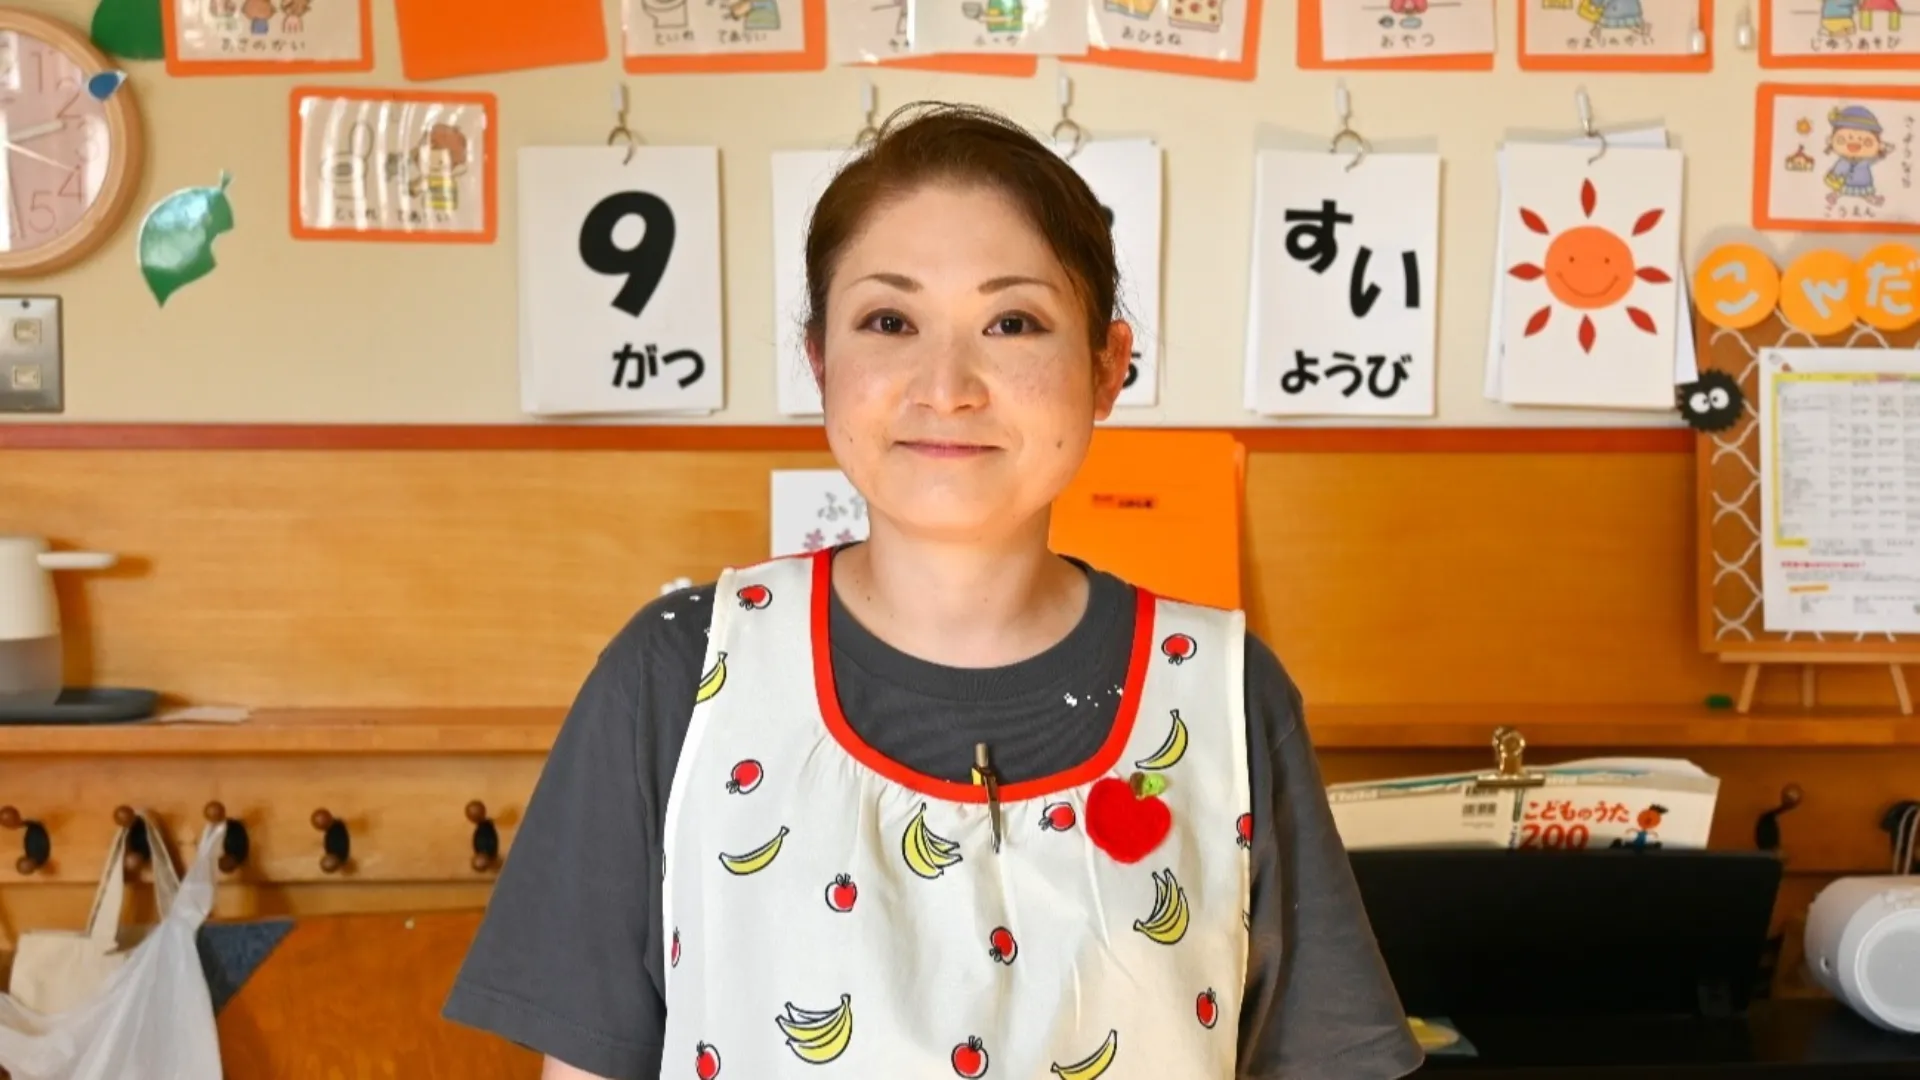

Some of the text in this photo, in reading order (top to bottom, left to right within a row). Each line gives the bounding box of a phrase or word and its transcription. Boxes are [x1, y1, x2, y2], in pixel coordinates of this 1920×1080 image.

[1121, 25, 1182, 46] おひるね
[1380, 32, 1436, 49] おやつ
[57, 162, 86, 204] 4
[29, 190, 57, 234] 5
[578, 190, 676, 319] 9
[1283, 199, 1422, 319] すい
[611, 342, 706, 390] がつ
[1280, 350, 1413, 399] ようび
[1523, 800, 1631, 824] こどものうた
[1519, 823, 1591, 850] 200
